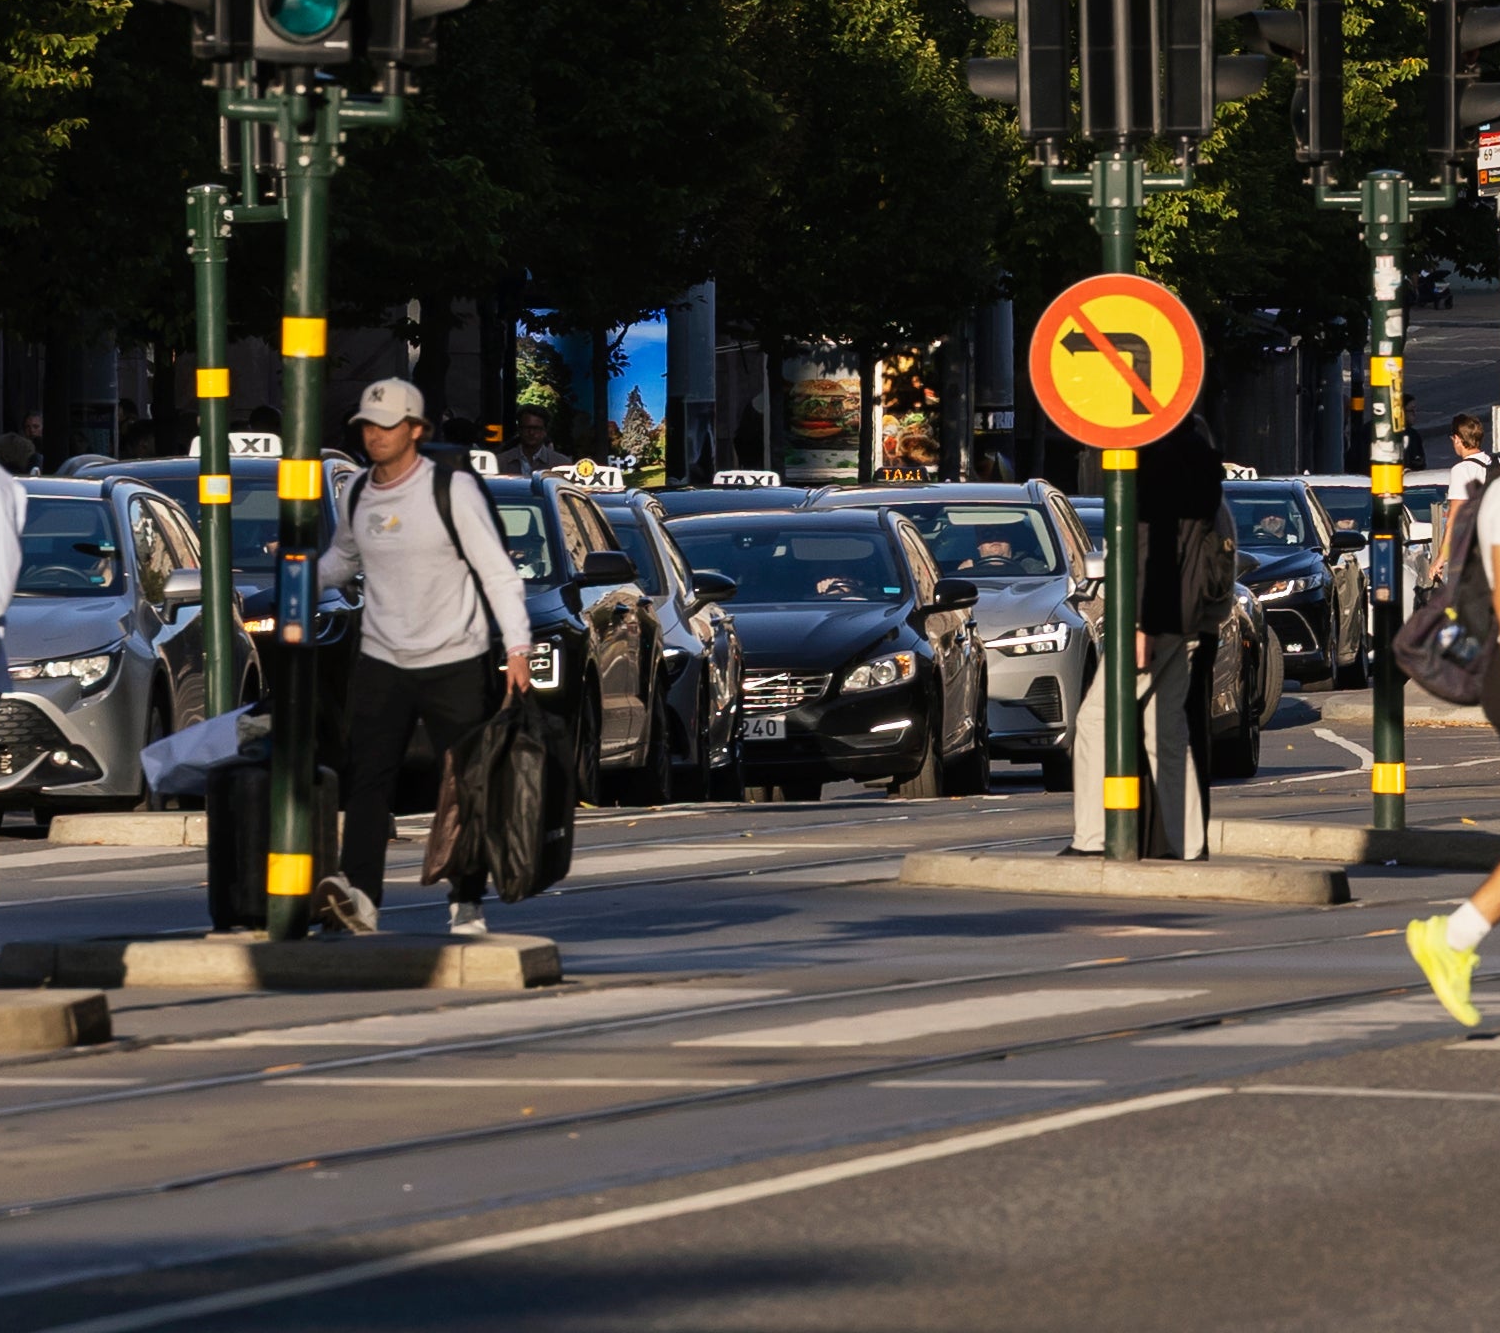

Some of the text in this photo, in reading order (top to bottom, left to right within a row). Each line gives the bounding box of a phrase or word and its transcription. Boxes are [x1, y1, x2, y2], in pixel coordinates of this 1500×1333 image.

[1483, 148, 1493, 161] 69
[228, 438, 271, 453] XI
[719, 475, 775, 485] TAXI
[1230, 469, 1253, 480] XI
[741, 720, 777, 737] 240
